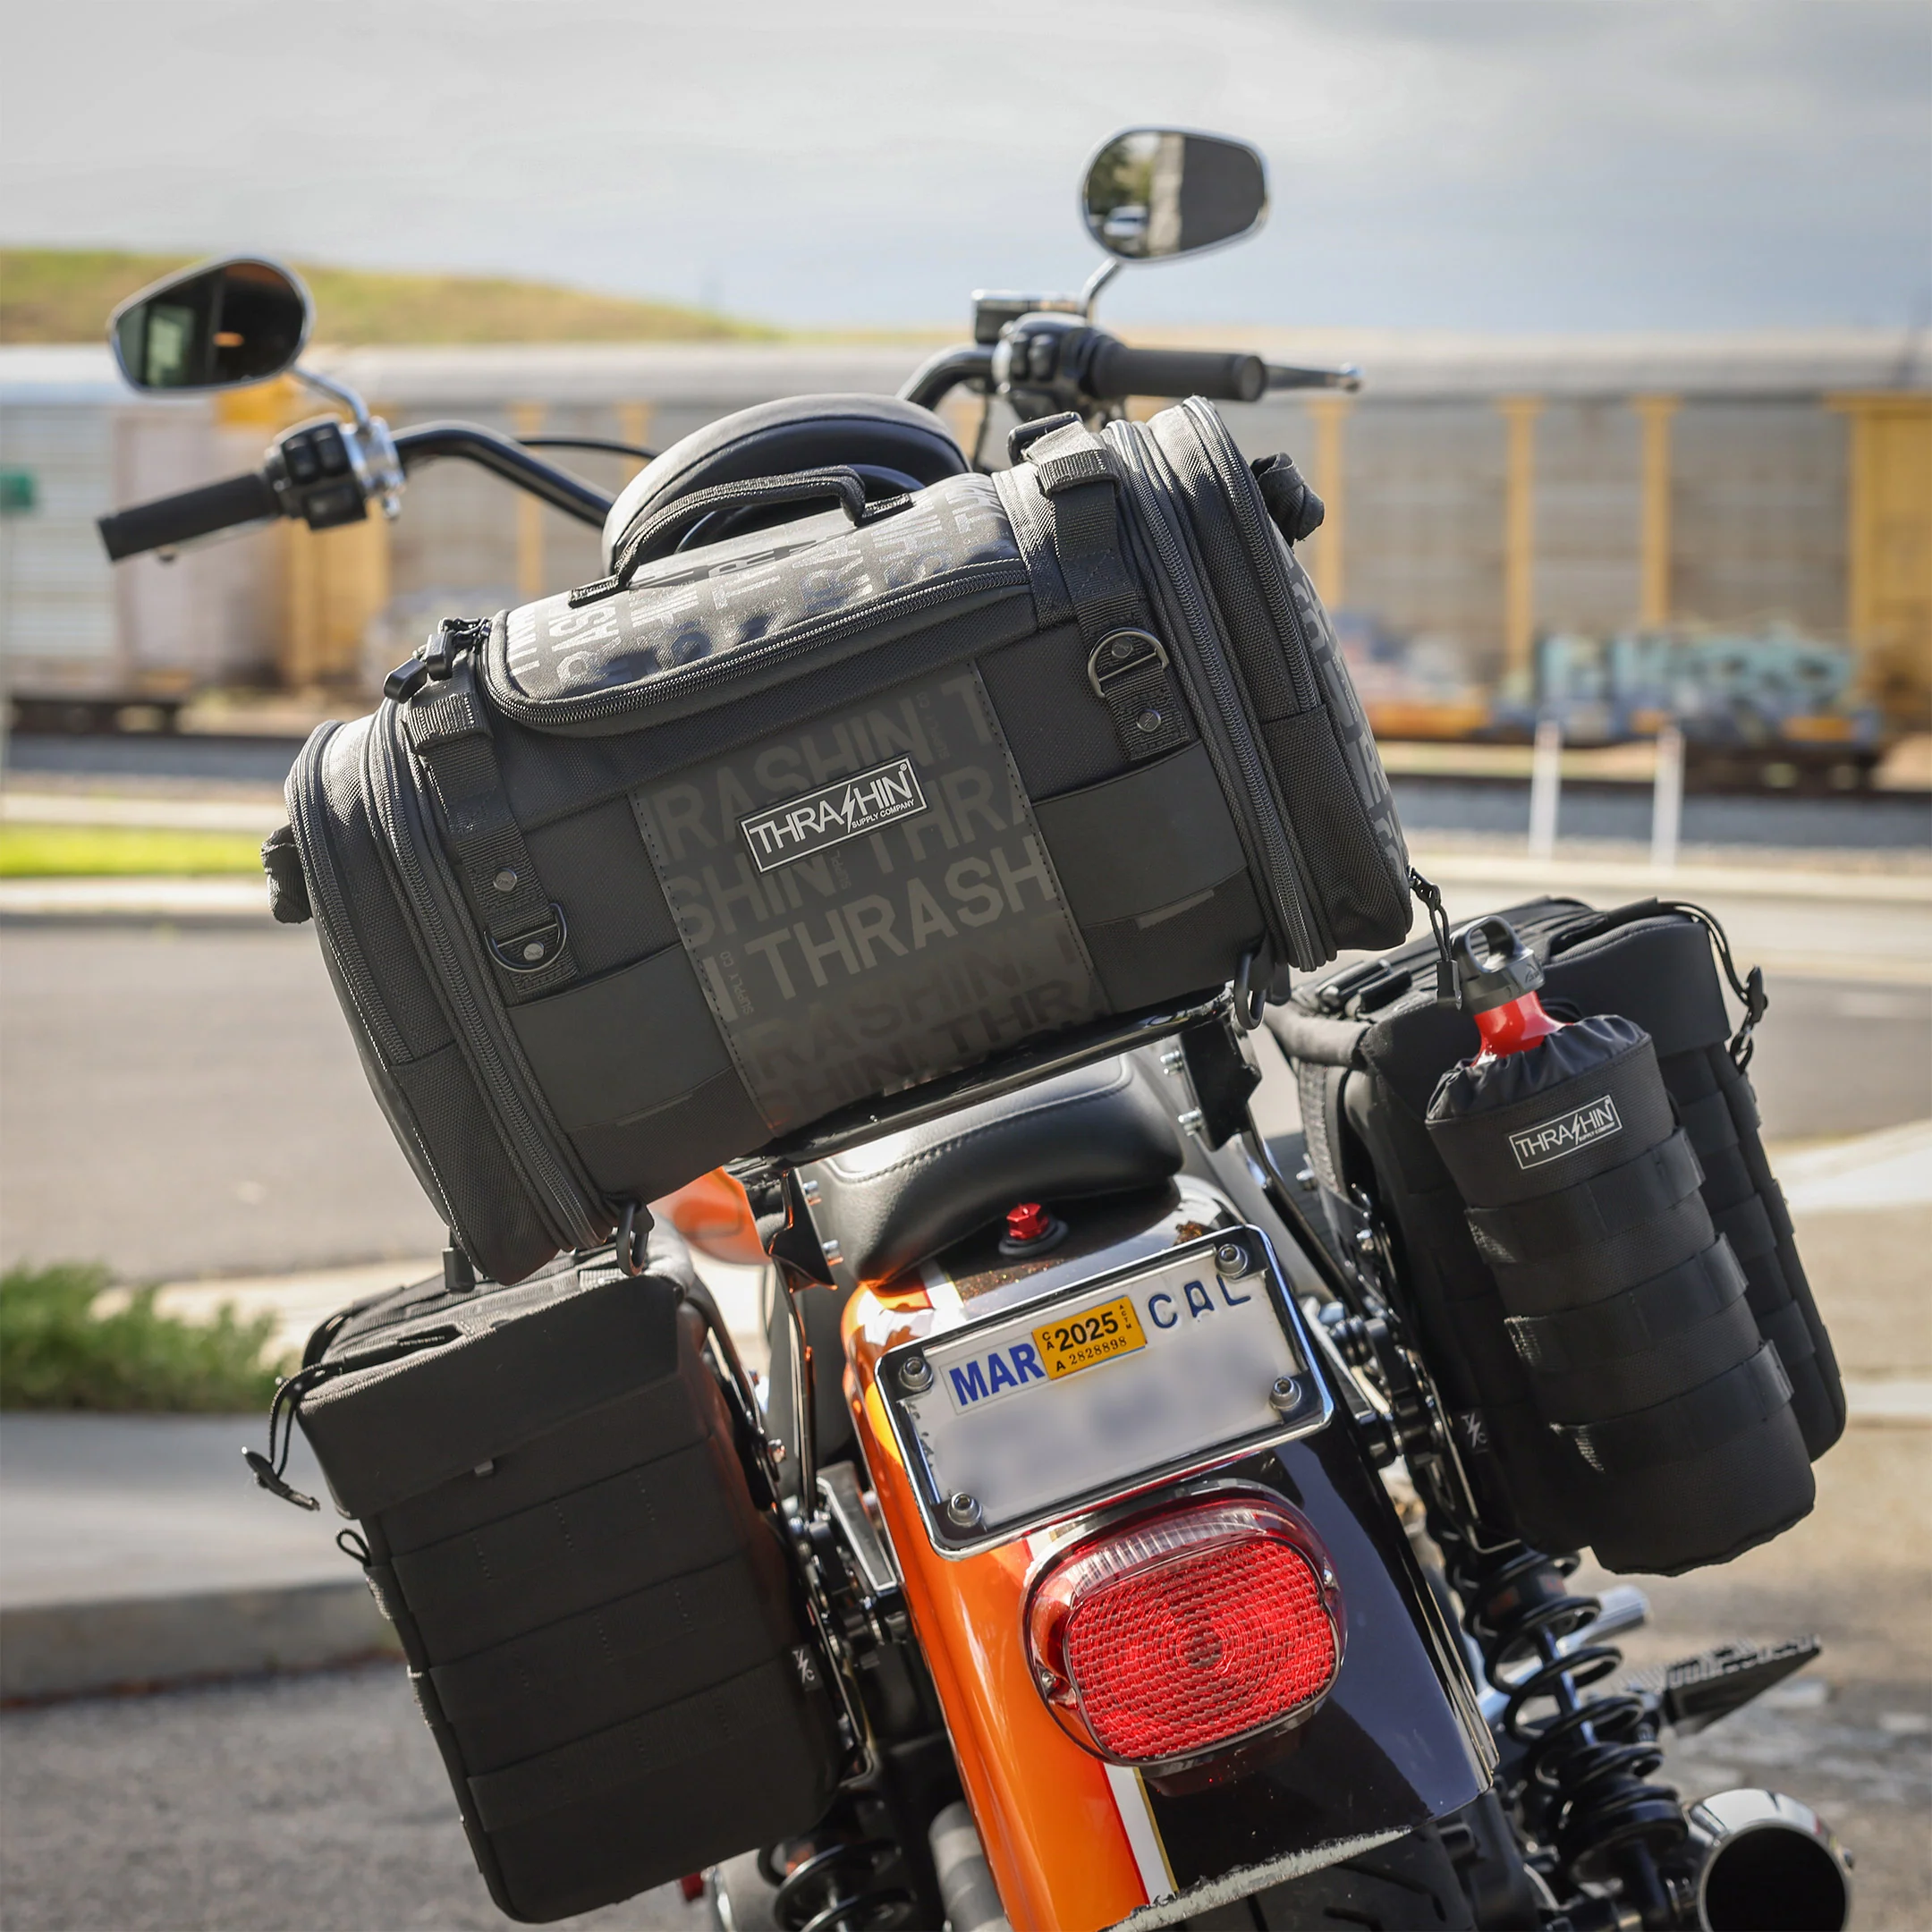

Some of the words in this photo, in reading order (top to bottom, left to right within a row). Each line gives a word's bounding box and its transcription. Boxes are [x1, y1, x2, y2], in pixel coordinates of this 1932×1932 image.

[852, 812, 879, 829] SUPPLY
[880, 799, 915, 818] COMPANY
[743, 835, 1057, 1001] THRASH
[1148, 1274, 1251, 1329] CAL
[1055, 1311, 1118, 1352] 2025
[949, 1343, 1046, 1406] MAR
[1055, 1360, 1066, 1372] A
